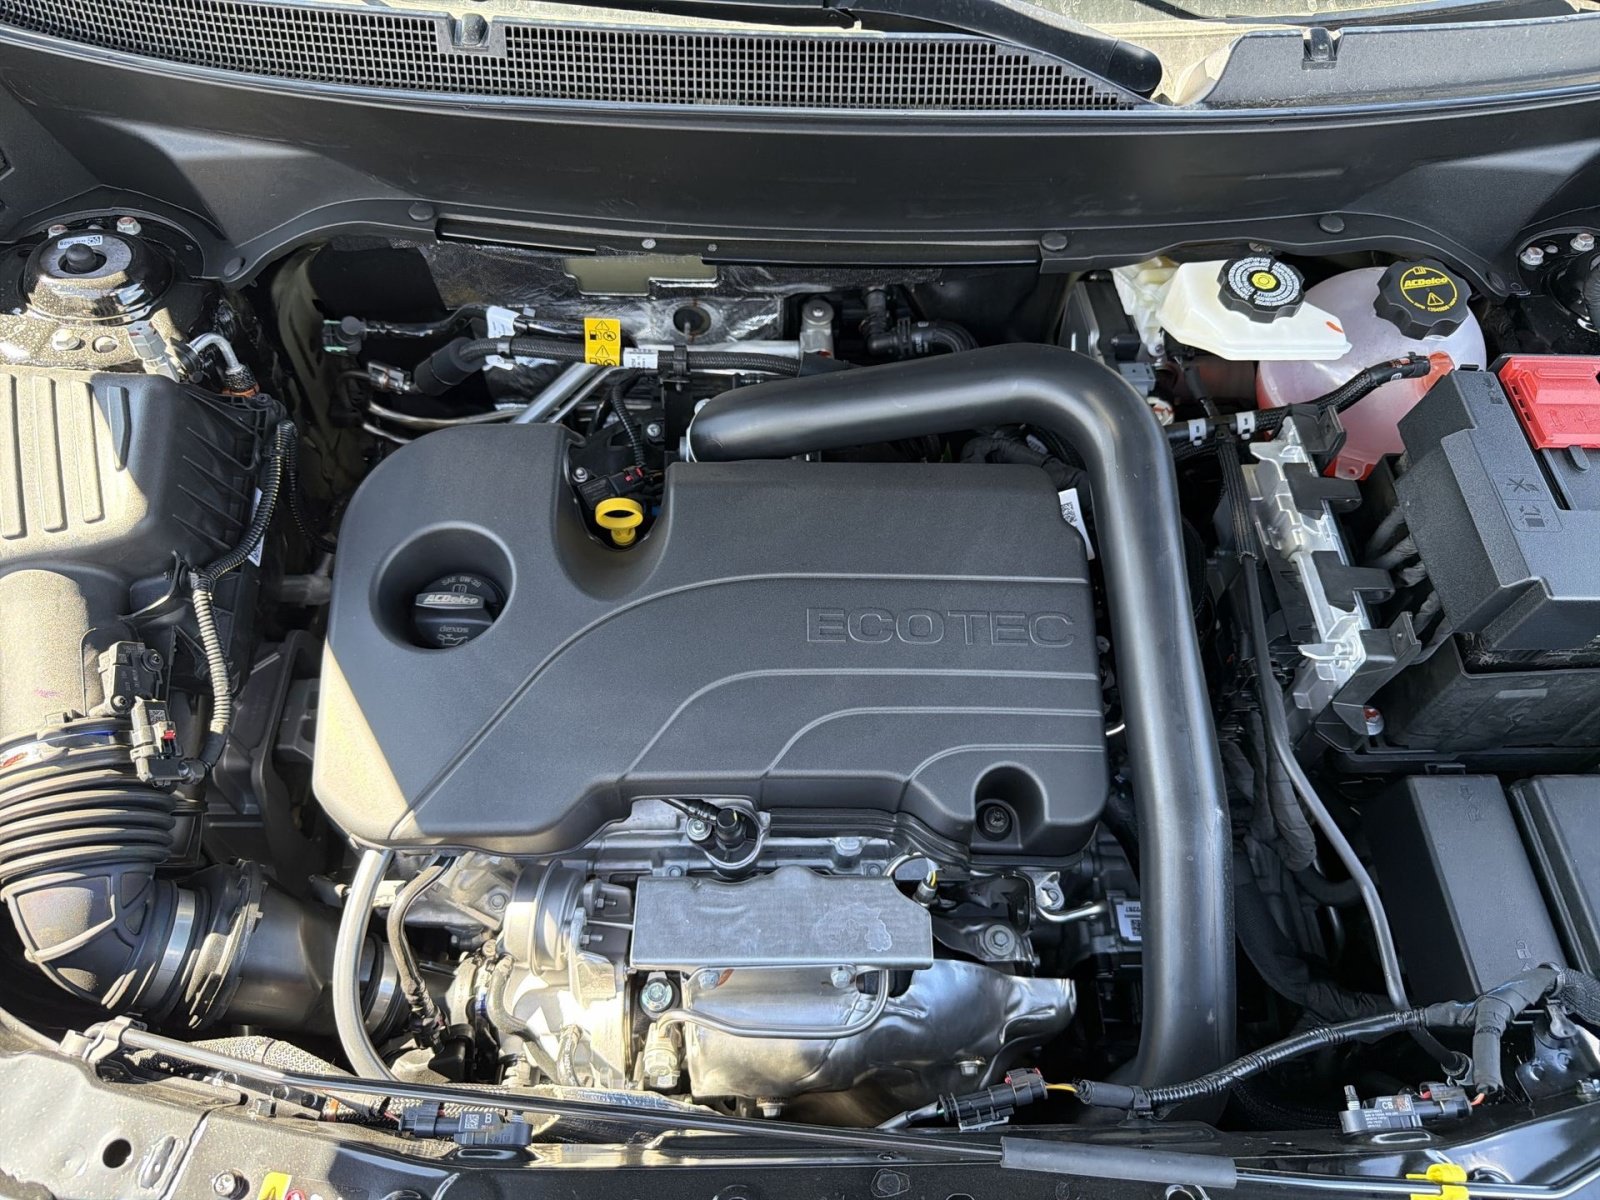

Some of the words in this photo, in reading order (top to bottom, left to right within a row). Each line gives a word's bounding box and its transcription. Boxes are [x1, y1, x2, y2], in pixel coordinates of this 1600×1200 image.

[1404, 277, 1448, 288] ACDelco
[423, 594, 479, 605] ACDelco
[806, 607, 1075, 648] ECOTEC
[1381, 1101, 1394, 1110] CB
[484, 1112, 493, 1124] B
